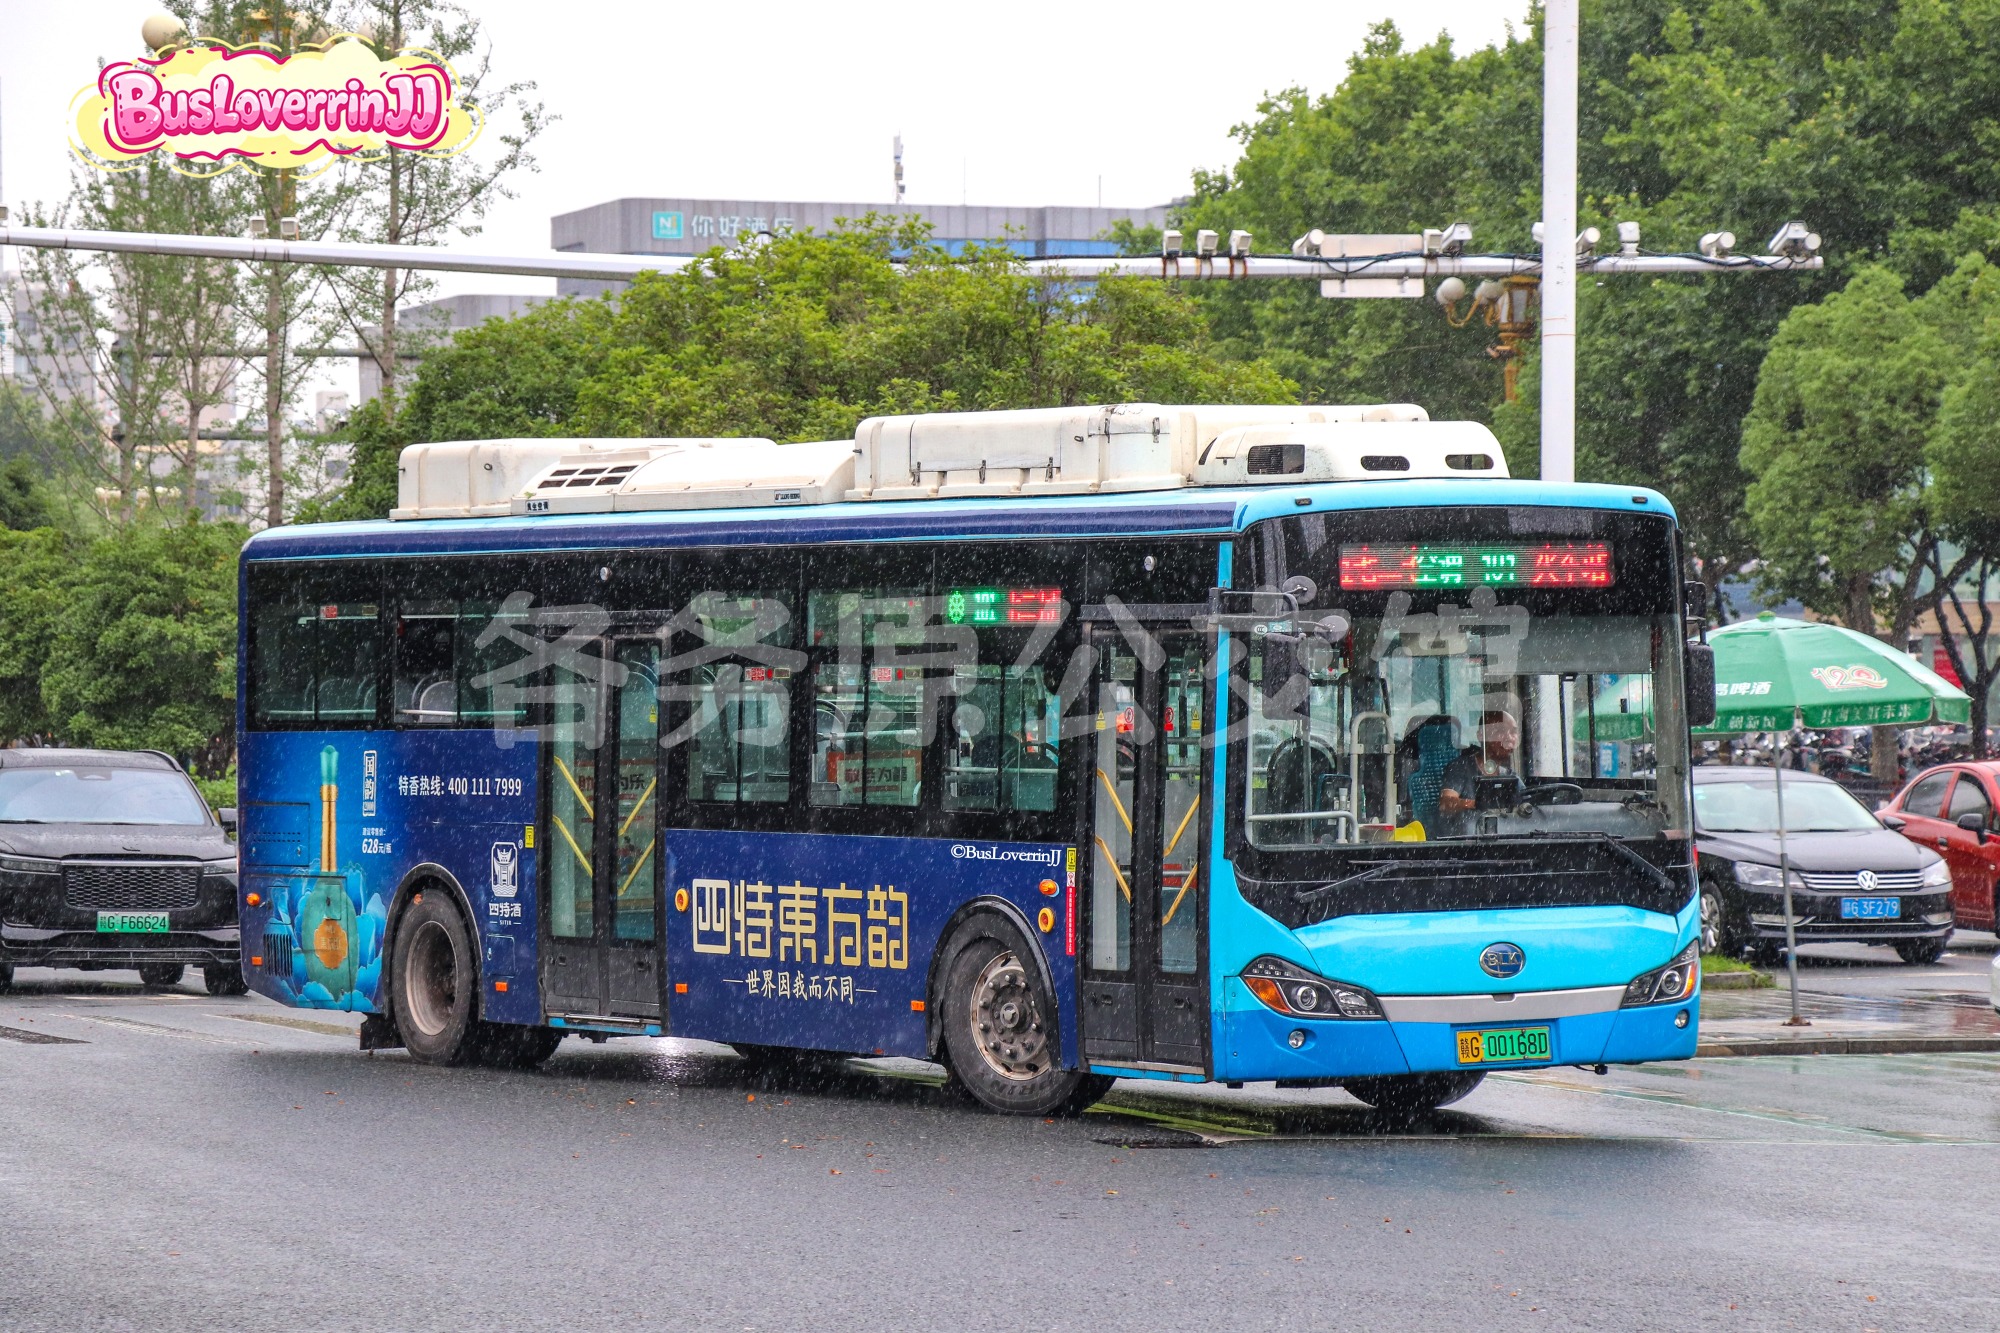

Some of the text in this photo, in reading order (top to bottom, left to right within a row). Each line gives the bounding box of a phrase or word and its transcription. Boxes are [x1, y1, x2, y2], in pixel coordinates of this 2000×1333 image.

[691, 214, 796, 238] 你好酒店
[398, 775, 522, 796] 特香热线: 400 111 7999
[489, 902, 522, 918] 四特酒
[745, 969, 854, 1005] 世界因我而不同
